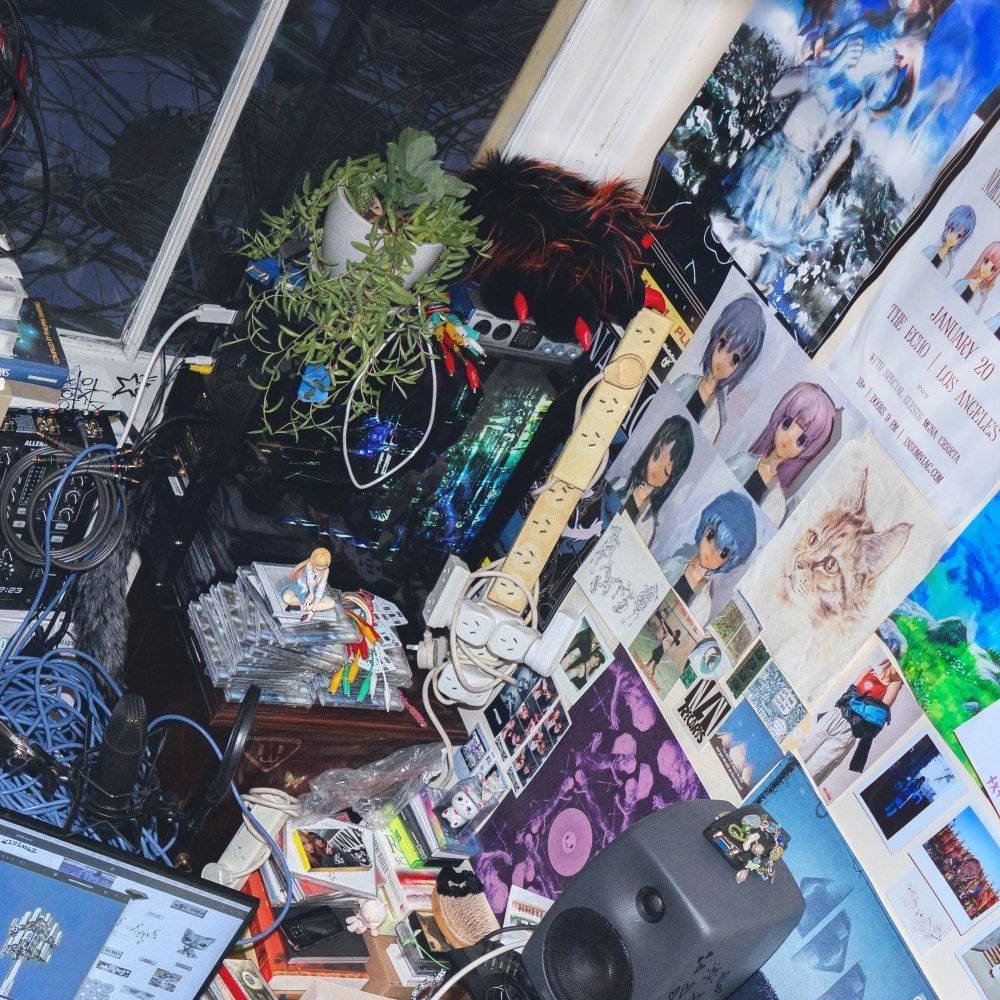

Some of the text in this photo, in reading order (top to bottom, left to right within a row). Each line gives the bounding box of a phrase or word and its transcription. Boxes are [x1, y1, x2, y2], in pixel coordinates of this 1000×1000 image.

[886, 303, 1000, 442] THE ECHO LOS ANGELES
[930, 306, 995, 381] JANUARY 20
[855, 376, 945, 485] 18+ DOORS 9 PM INSOMNIAC.COM
[869, 351, 886, 373] WITH
[882, 368, 905, 399] SPECIAL
[902, 394, 924, 422] GUESTS
[921, 418, 939, 439] MGNA
[375, 852, 391, 873] REILLY
